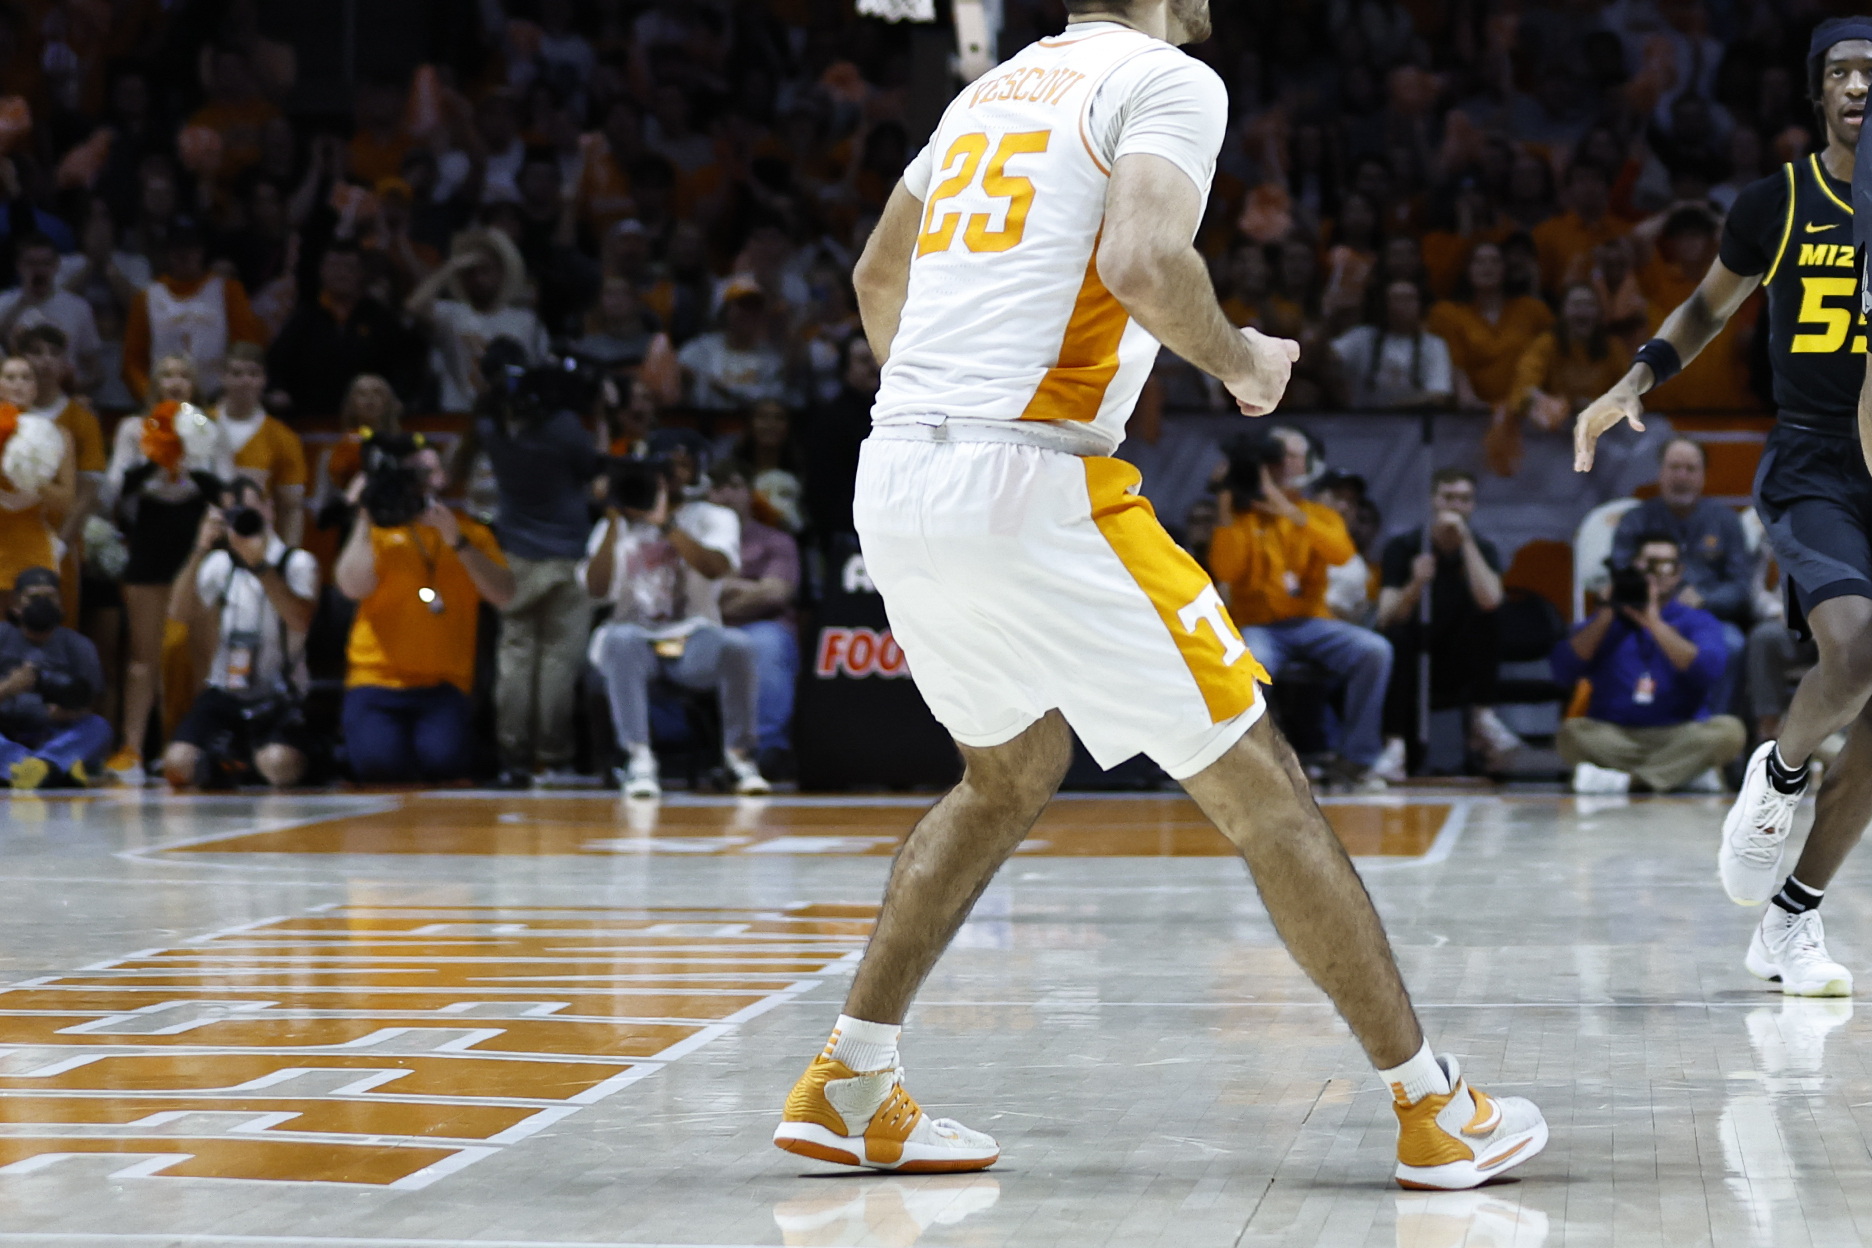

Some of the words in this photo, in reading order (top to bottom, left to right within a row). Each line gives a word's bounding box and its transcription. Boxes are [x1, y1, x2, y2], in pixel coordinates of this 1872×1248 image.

[967, 67, 1086, 109] VESCOVI
[916, 129, 1052, 260] 25
[816, 625, 912, 679] FOO
[1176, 581, 1247, 667] T
